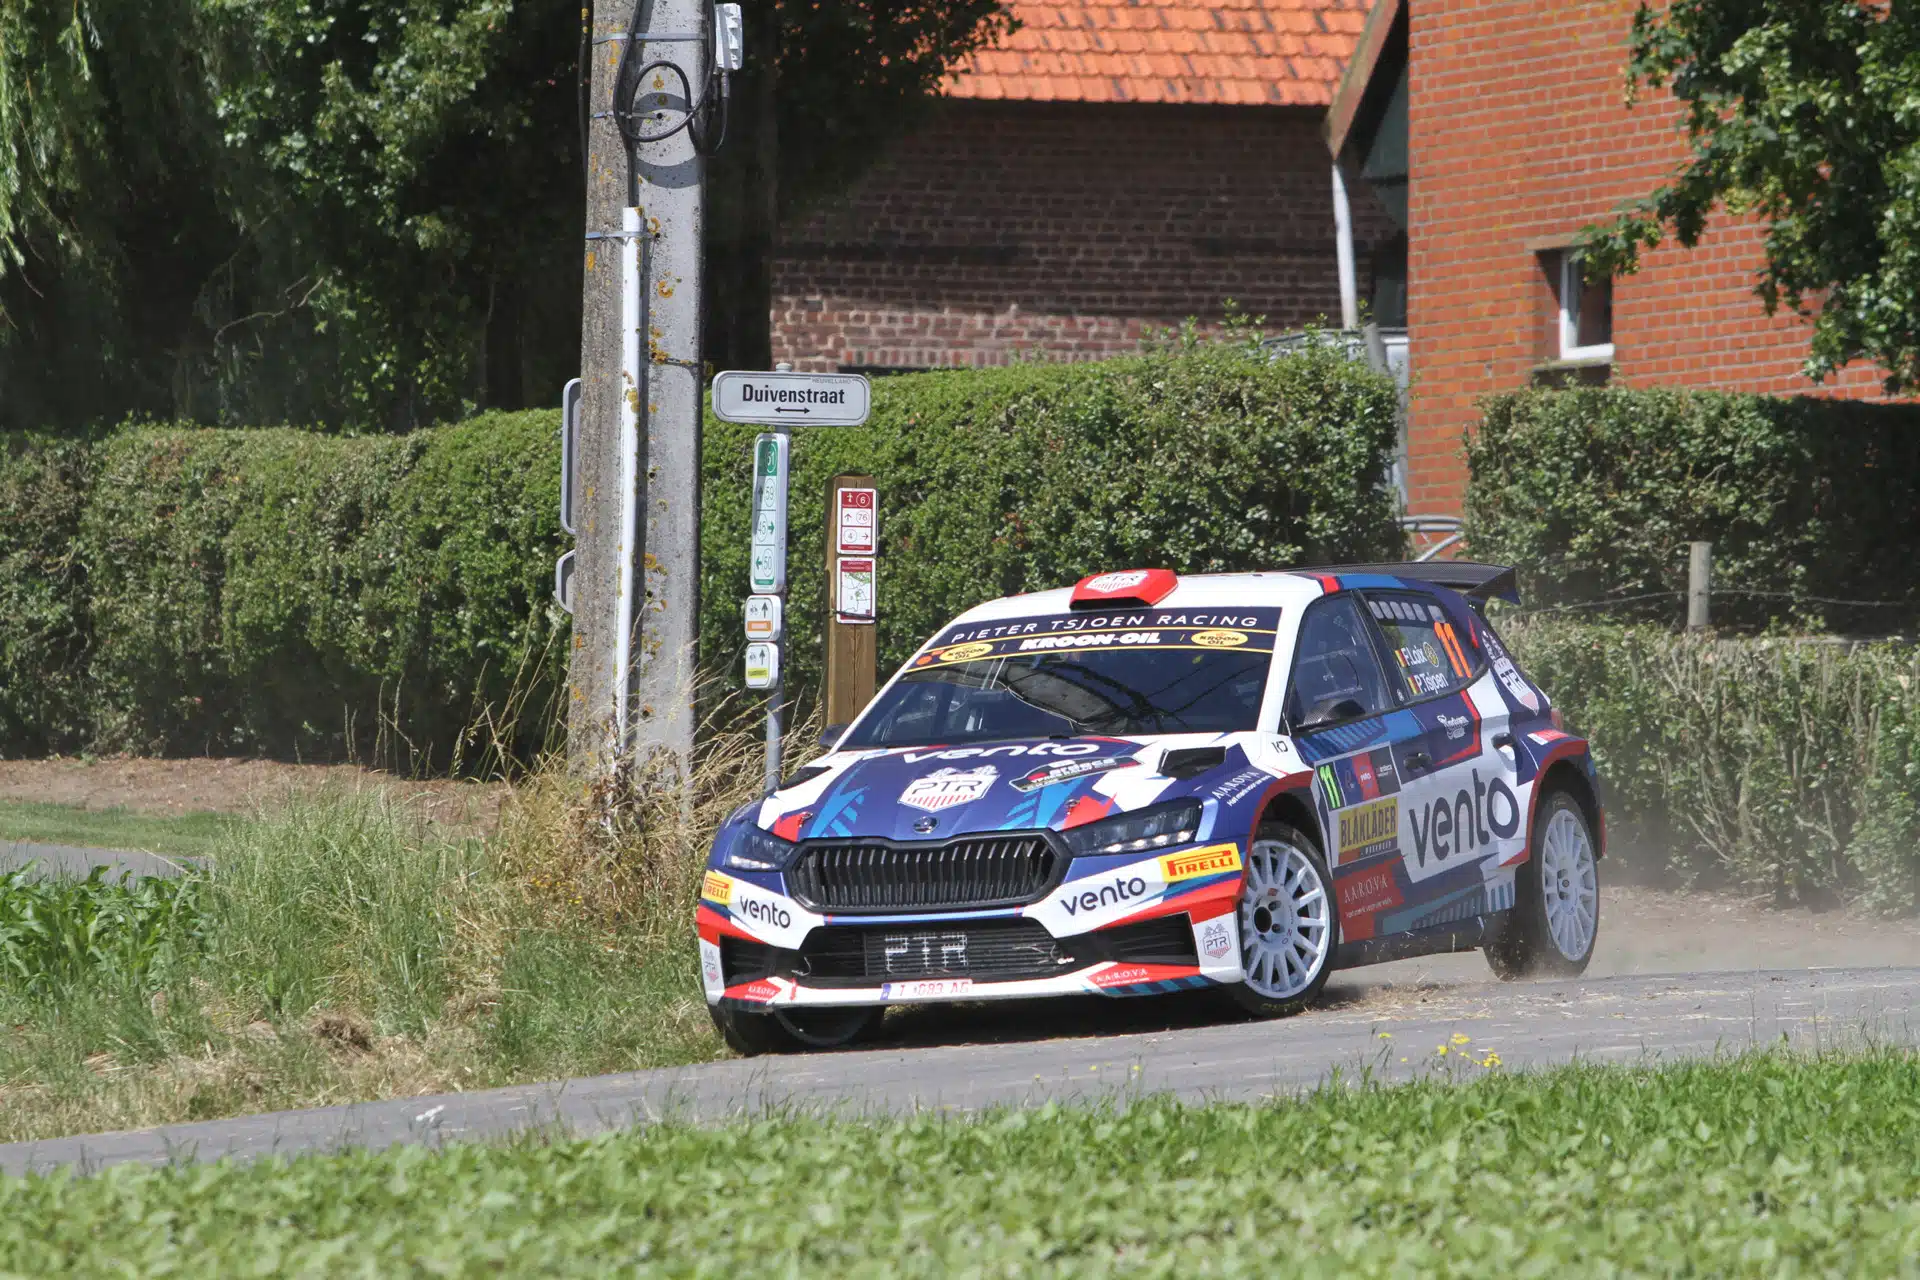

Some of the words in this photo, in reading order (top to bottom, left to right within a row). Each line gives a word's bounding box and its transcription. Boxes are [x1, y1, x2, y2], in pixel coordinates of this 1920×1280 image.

[742, 384, 845, 404] Duivenstraat
[860, 496, 866, 504] 6
[858, 513, 868, 521] 76
[951, 622, 1038, 643] PIETER
[1051, 615, 1143, 630] TSJOEN
[1160, 614, 1258, 627] RACING
[1019, 632, 1161, 650] KROON-OIL
[1433, 622, 1472, 678] 11
[903, 743, 1100, 763] vento
[912, 780, 982, 795] PTR
[1319, 764, 1341, 809] 11
[1408, 768, 1520, 868] vento
[1166, 850, 1234, 877] PIRELLI
[1060, 877, 1146, 916] vento
[740, 896, 791, 928] vento
[885, 934, 967, 974] PTR
[1205, 936, 1228, 950] PTR
